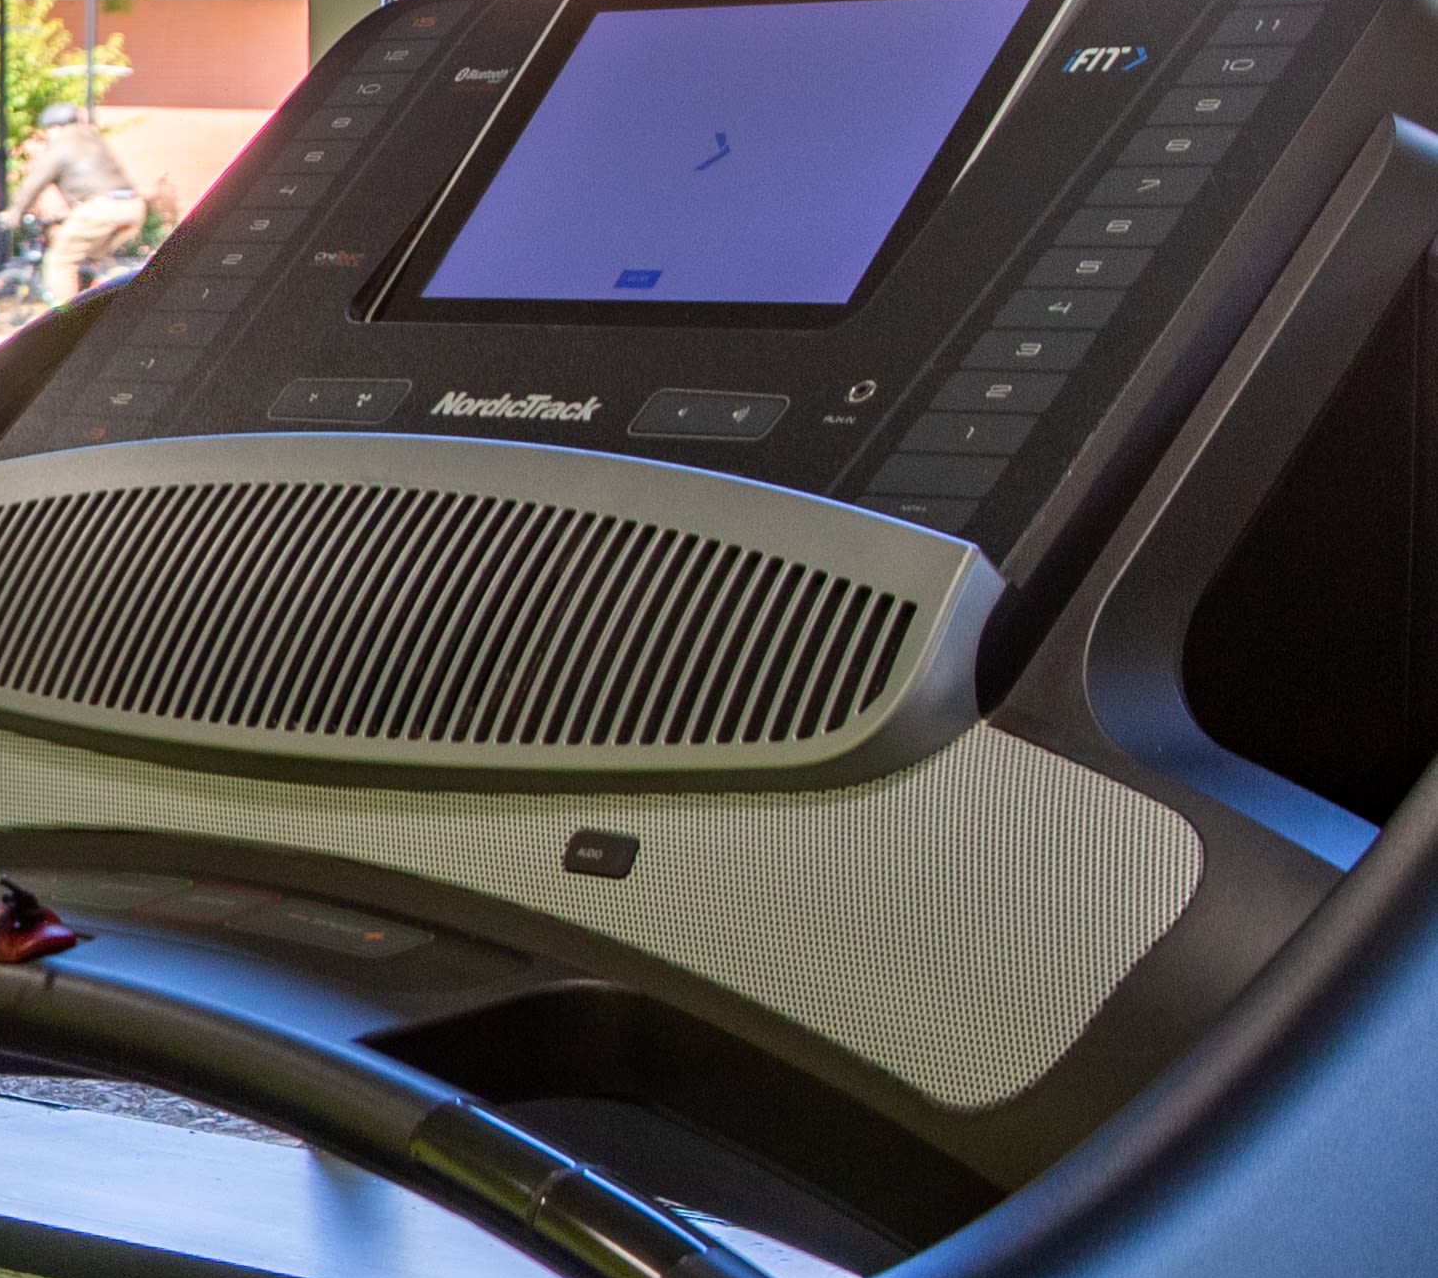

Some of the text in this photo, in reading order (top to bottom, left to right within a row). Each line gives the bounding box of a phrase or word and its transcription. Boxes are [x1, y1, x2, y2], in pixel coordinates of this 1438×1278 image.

[1255, 19, 1280, 32] 11
[1062, 46, 1132, 73] iFIT
[1222, 58, 1255, 72] 10
[356, 84, 381, 95] 10
[1195, 99, 1222, 111] 9
[1165, 139, 1192, 151] 8
[279, 185, 298, 196] 4
[1137, 179, 1161, 192] 7
[250, 220, 270, 231] 3
[1105, 220, 1132, 233] 6
[222, 254, 243, 265] 2
[1076, 260, 1102, 274] 5
[202, 288, 210, 300] 1
[1048, 301, 1072, 314] 4
[1016, 343, 1042, 357] 3
[985, 384, 1012, 399] 2
[431, 391, 603, 422] NordicTrack
[966, 426, 975, 439] 1
